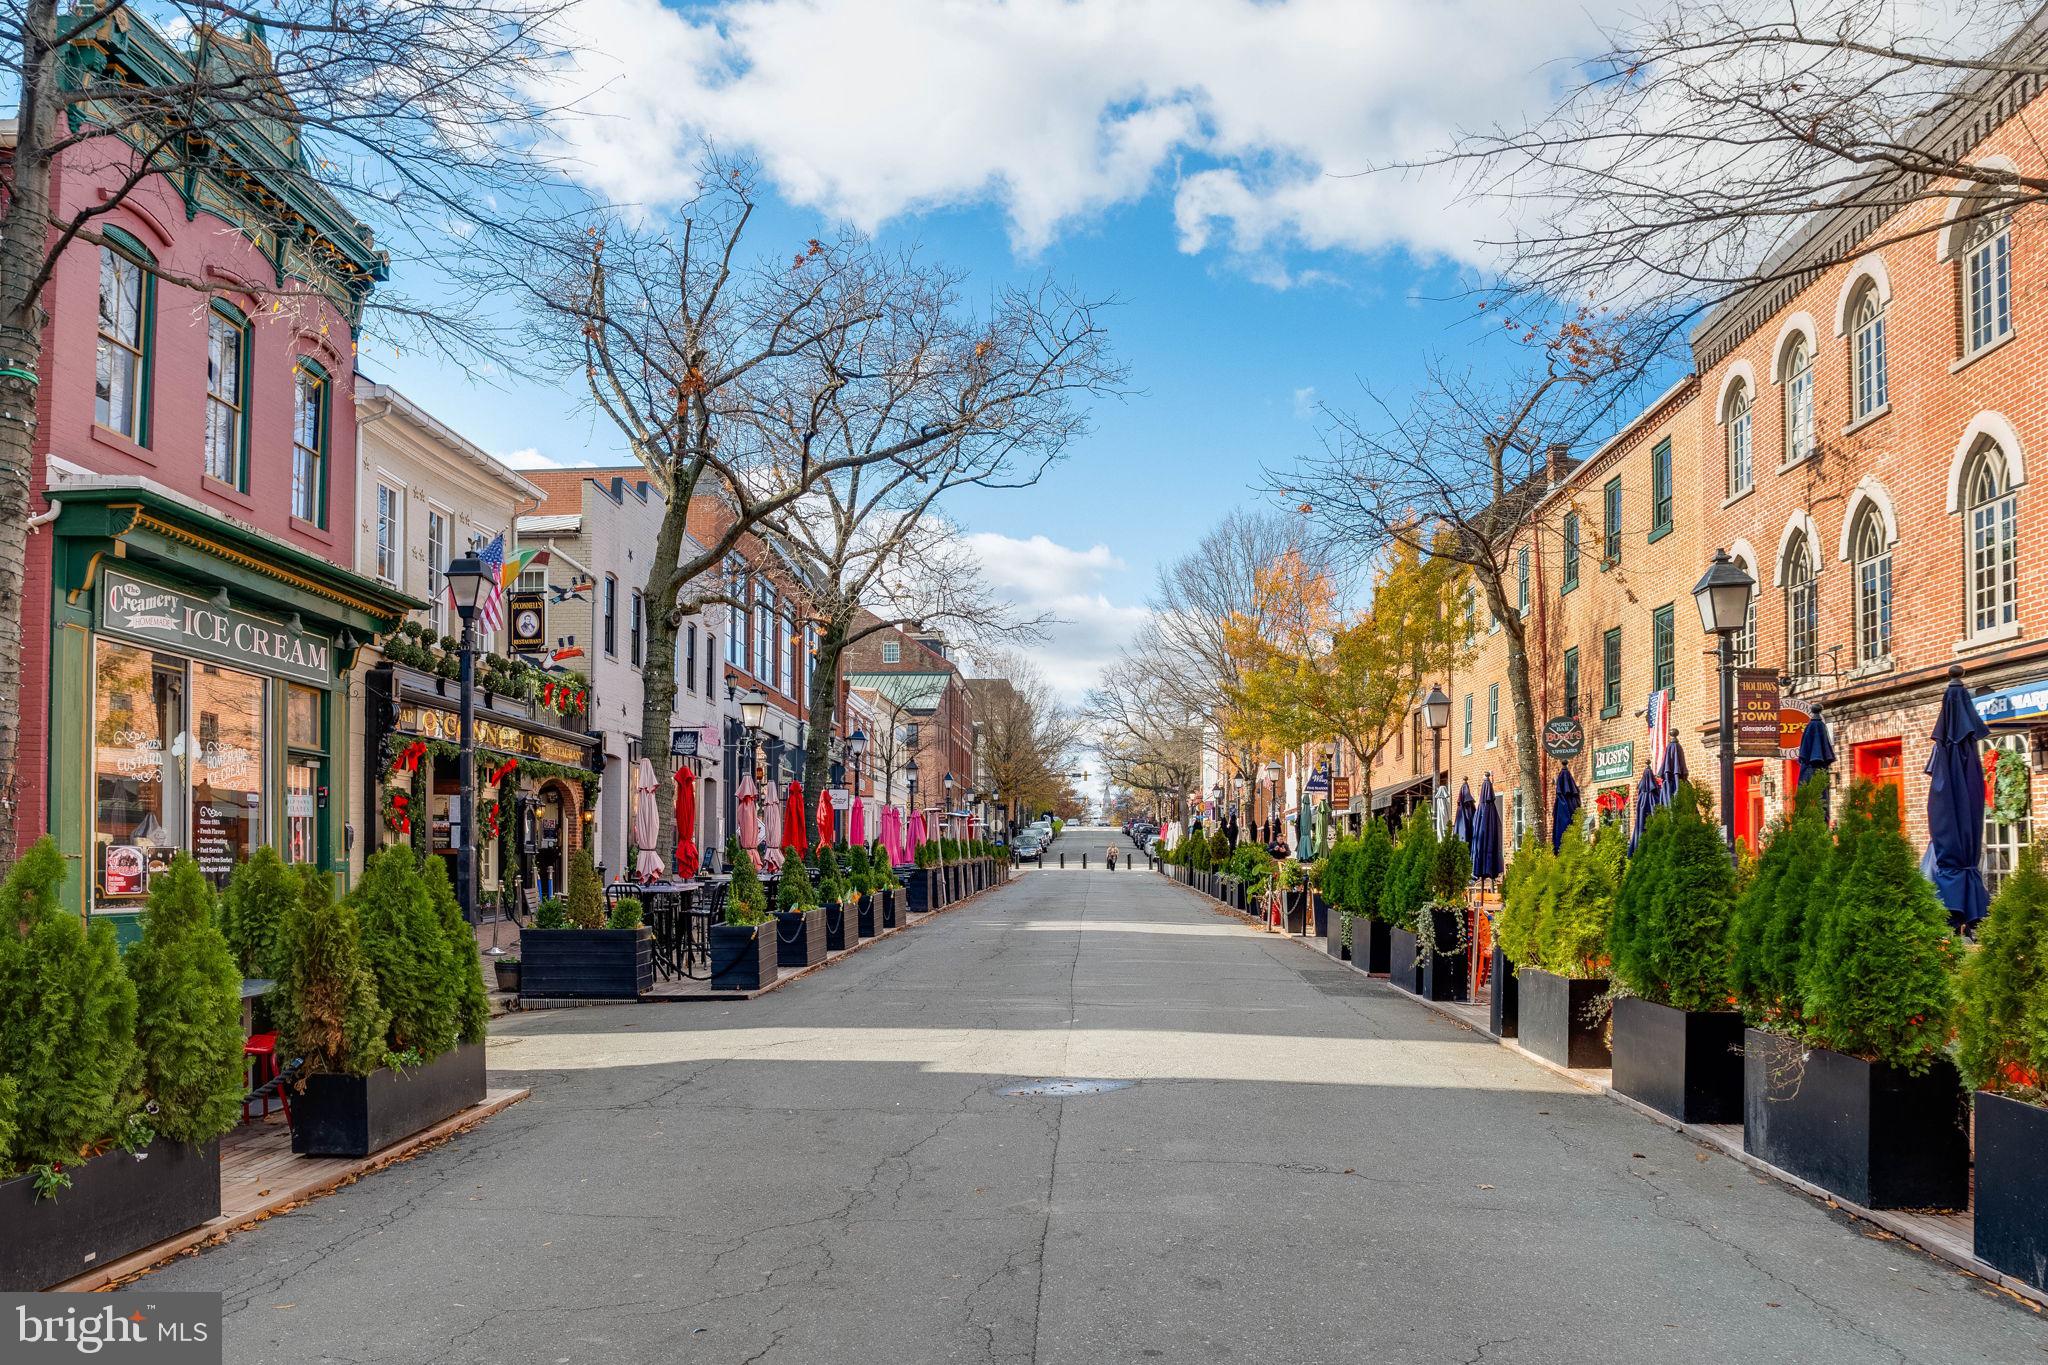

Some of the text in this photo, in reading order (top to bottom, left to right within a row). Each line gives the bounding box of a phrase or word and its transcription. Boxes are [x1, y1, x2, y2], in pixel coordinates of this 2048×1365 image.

[110, 585, 179, 613] Creamery
[182, 606, 327, 671] ICE CREAM
[1740, 682, 1777, 693] HOLIDAYS
[1747, 701, 1771, 711] OLD
[1780, 699, 1811, 715] ASHION
[1741, 712, 1777, 721] TOWN
[422, 711, 541, 753] O'CNNELL'S
[1545, 730, 1582, 742] BUGSY'S
[117, 752, 163, 772] CUSTARD
[1595, 746, 1630, 768] BUGSY'S
